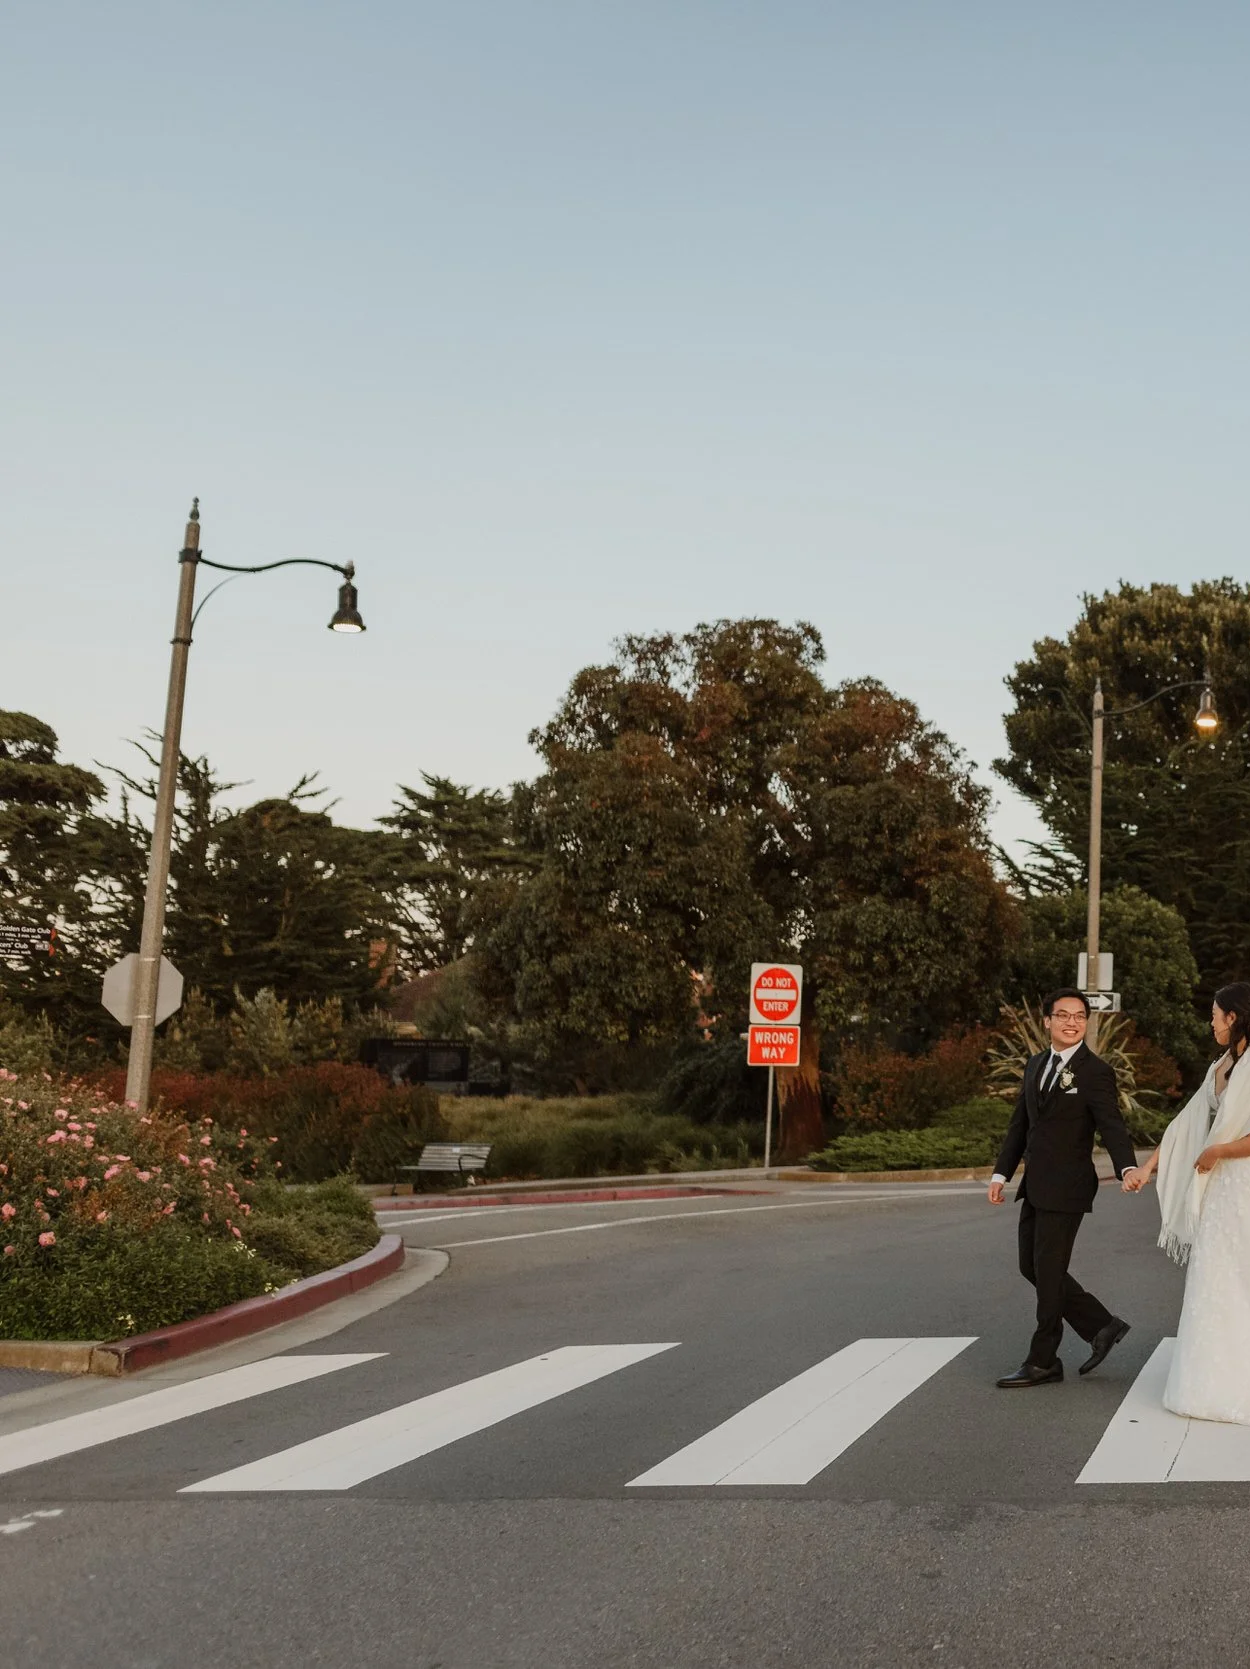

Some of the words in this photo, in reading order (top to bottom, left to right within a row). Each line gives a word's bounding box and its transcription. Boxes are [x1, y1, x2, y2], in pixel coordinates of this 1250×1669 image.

[761, 977, 774, 987] DO
[776, 977, 792, 988] NOT
[763, 1001, 789, 1012] ENTER
[755, 1031, 794, 1045] WRONG
[761, 1047, 786, 1059] WAY
